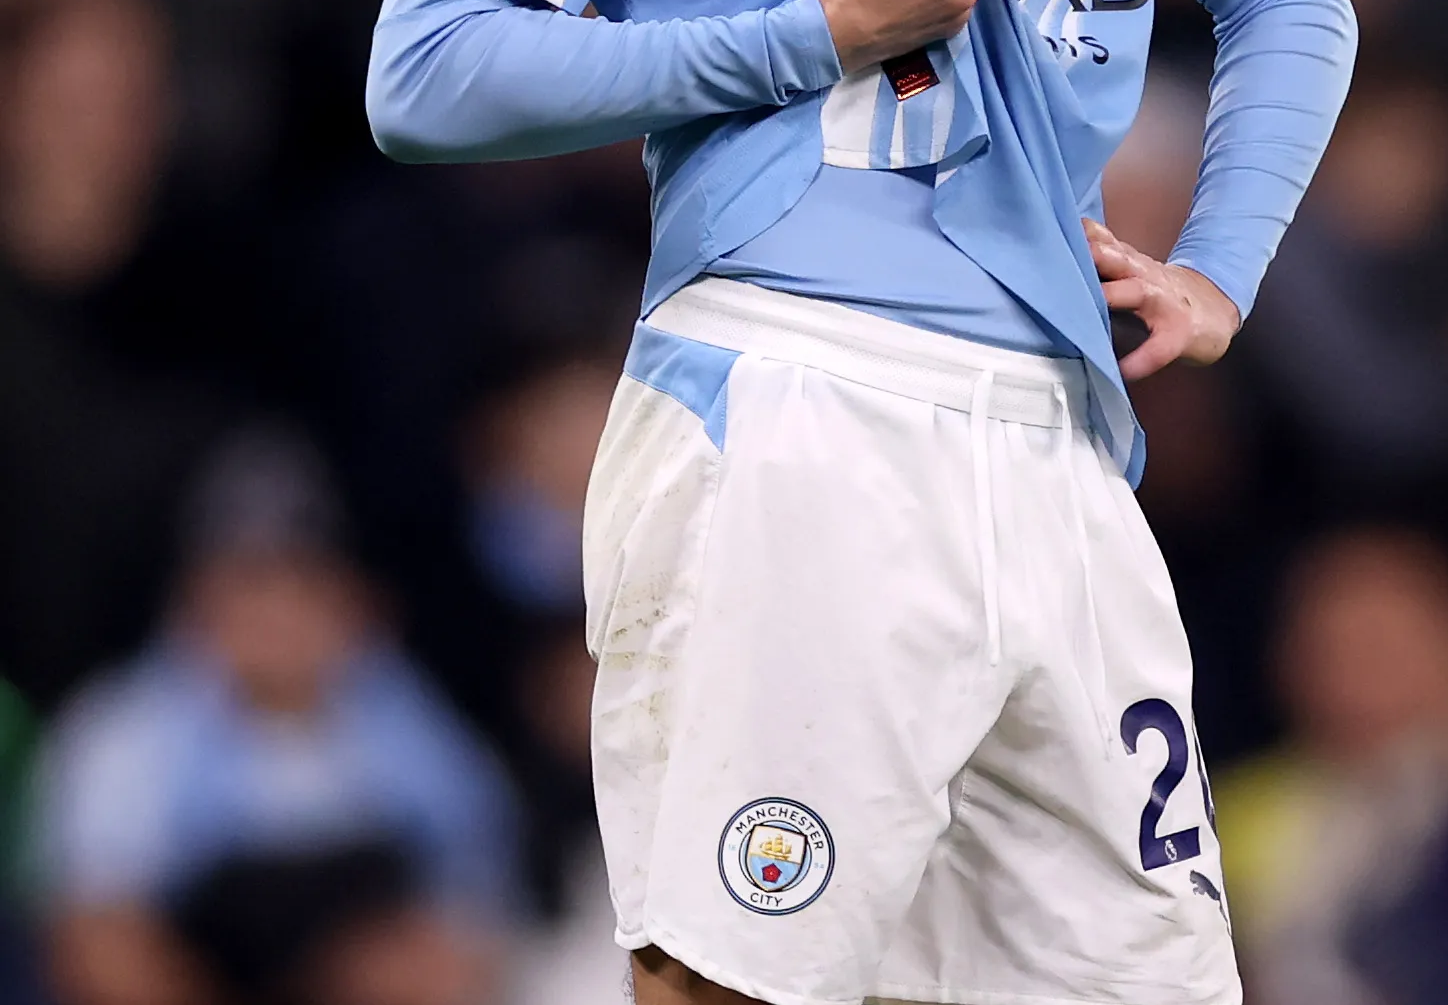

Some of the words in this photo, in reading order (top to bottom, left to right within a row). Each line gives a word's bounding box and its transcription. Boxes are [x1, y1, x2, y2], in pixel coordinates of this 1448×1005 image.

[1119, 697, 1216, 872] 2
[735, 806, 825, 850] MANCHESTER
[750, 892, 783, 907] CITY
